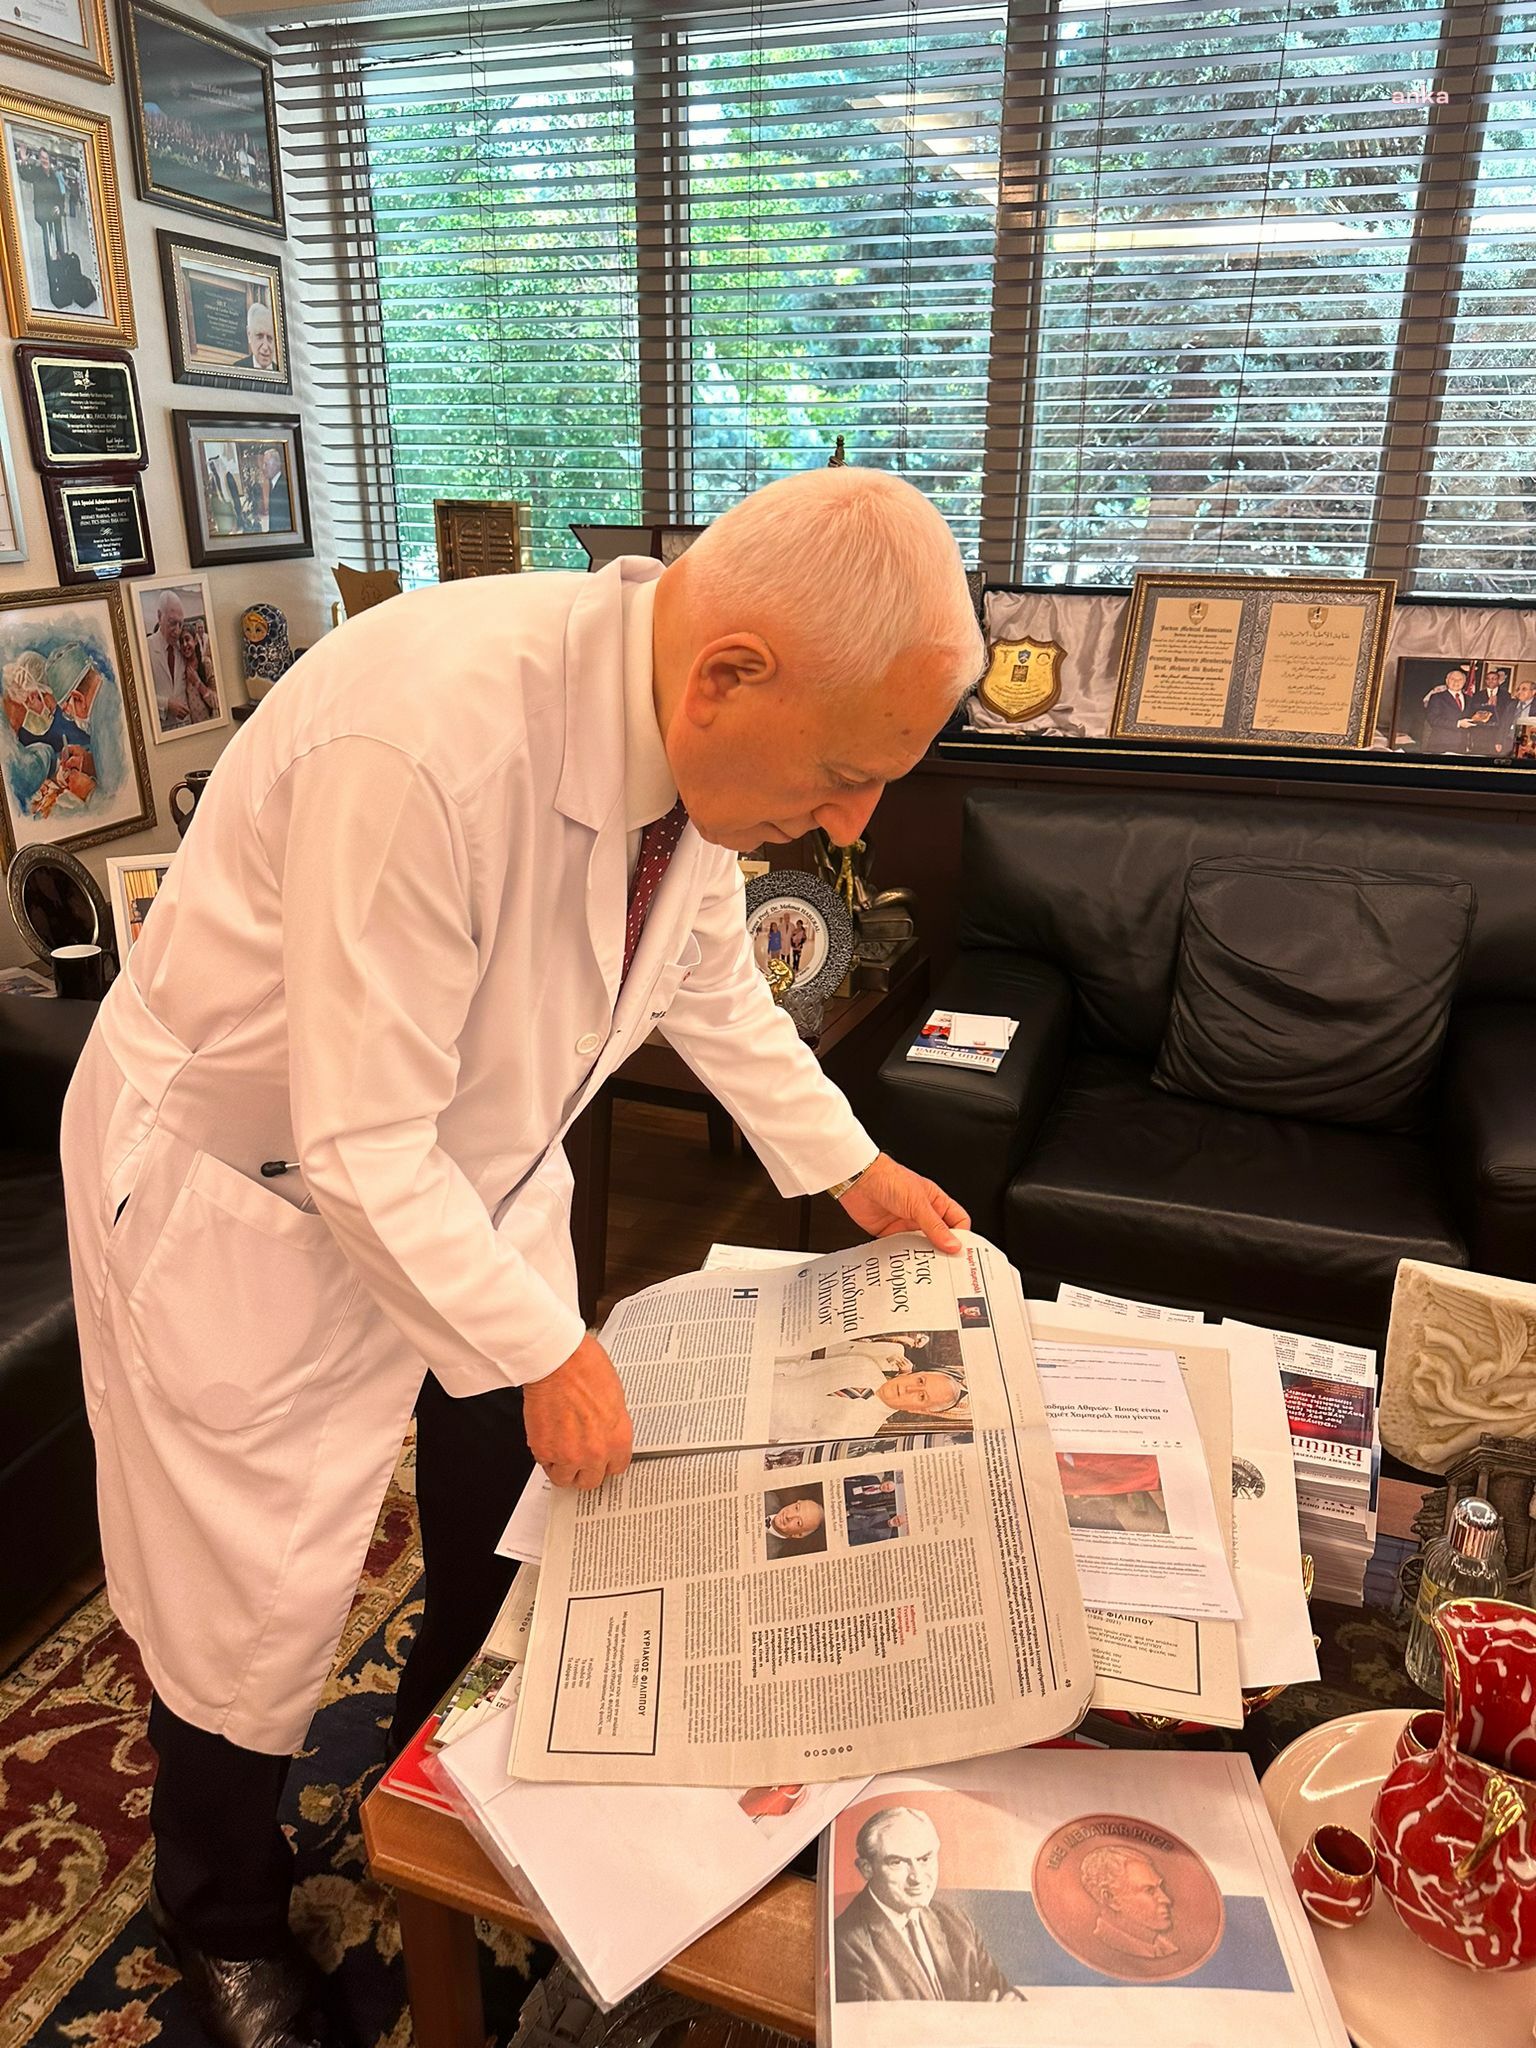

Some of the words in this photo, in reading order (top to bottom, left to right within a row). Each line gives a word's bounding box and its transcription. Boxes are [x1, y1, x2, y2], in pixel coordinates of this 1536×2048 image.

[865, 1257, 883, 1287] στην
[886, 1249, 913, 1313] Τούρκος
[914, 1249, 935, 1284] Ενας
[818, 1271, 839, 1325] Αθηνών
[838, 1265, 864, 1333] Ακαδημία
[1338, 1410, 1364, 1418] hayat
[1292, 1438, 1361, 1461] Bütün
[1107, 1612, 1153, 1625] ΦΙΛΙΠΠΟΥ
[642, 1630, 650, 1672] ΚΥΡΙΑΚΟΣ
[639, 1675, 647, 1715] ΦΙΛΙΠΠΟΥ
[1065, 1679, 1071, 1687] 49
[1047, 1845, 1067, 1870] THE
[1064, 1822, 1130, 1849] MEDAWAR
[1132, 1828, 1173, 1853] PRIZE
